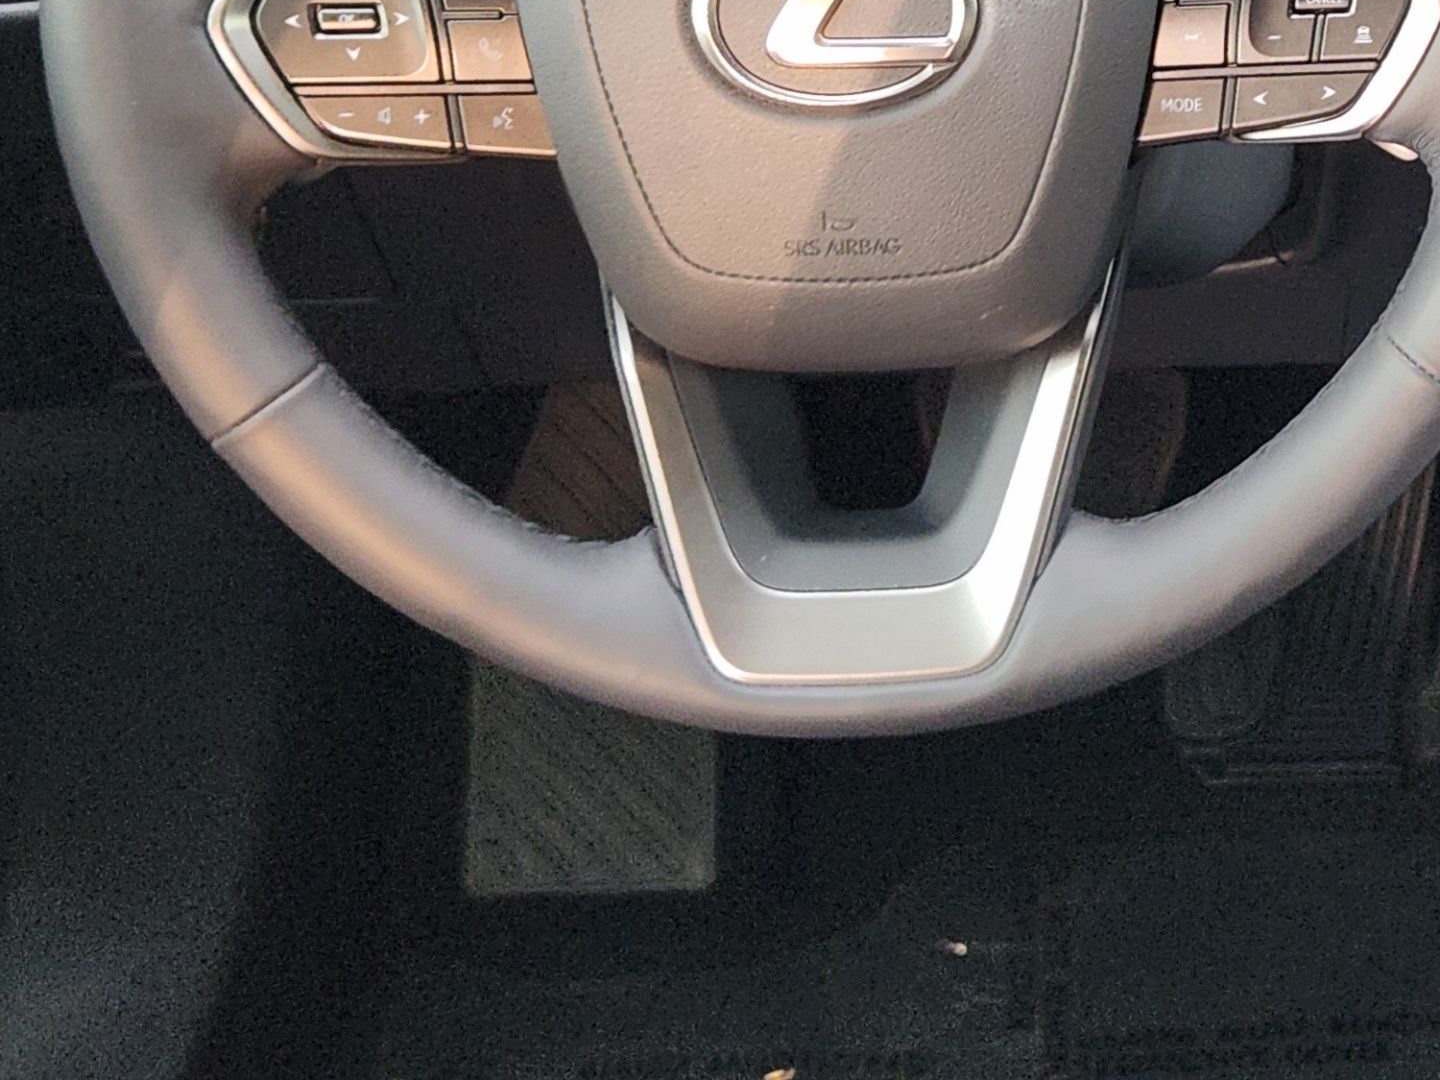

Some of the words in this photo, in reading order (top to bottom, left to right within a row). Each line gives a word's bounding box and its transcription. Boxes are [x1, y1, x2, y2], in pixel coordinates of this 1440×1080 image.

[1161, 97, 1203, 112] MODE
[784, 238, 820, 257] SRS
[824, 238, 902, 258] AIRBAG
